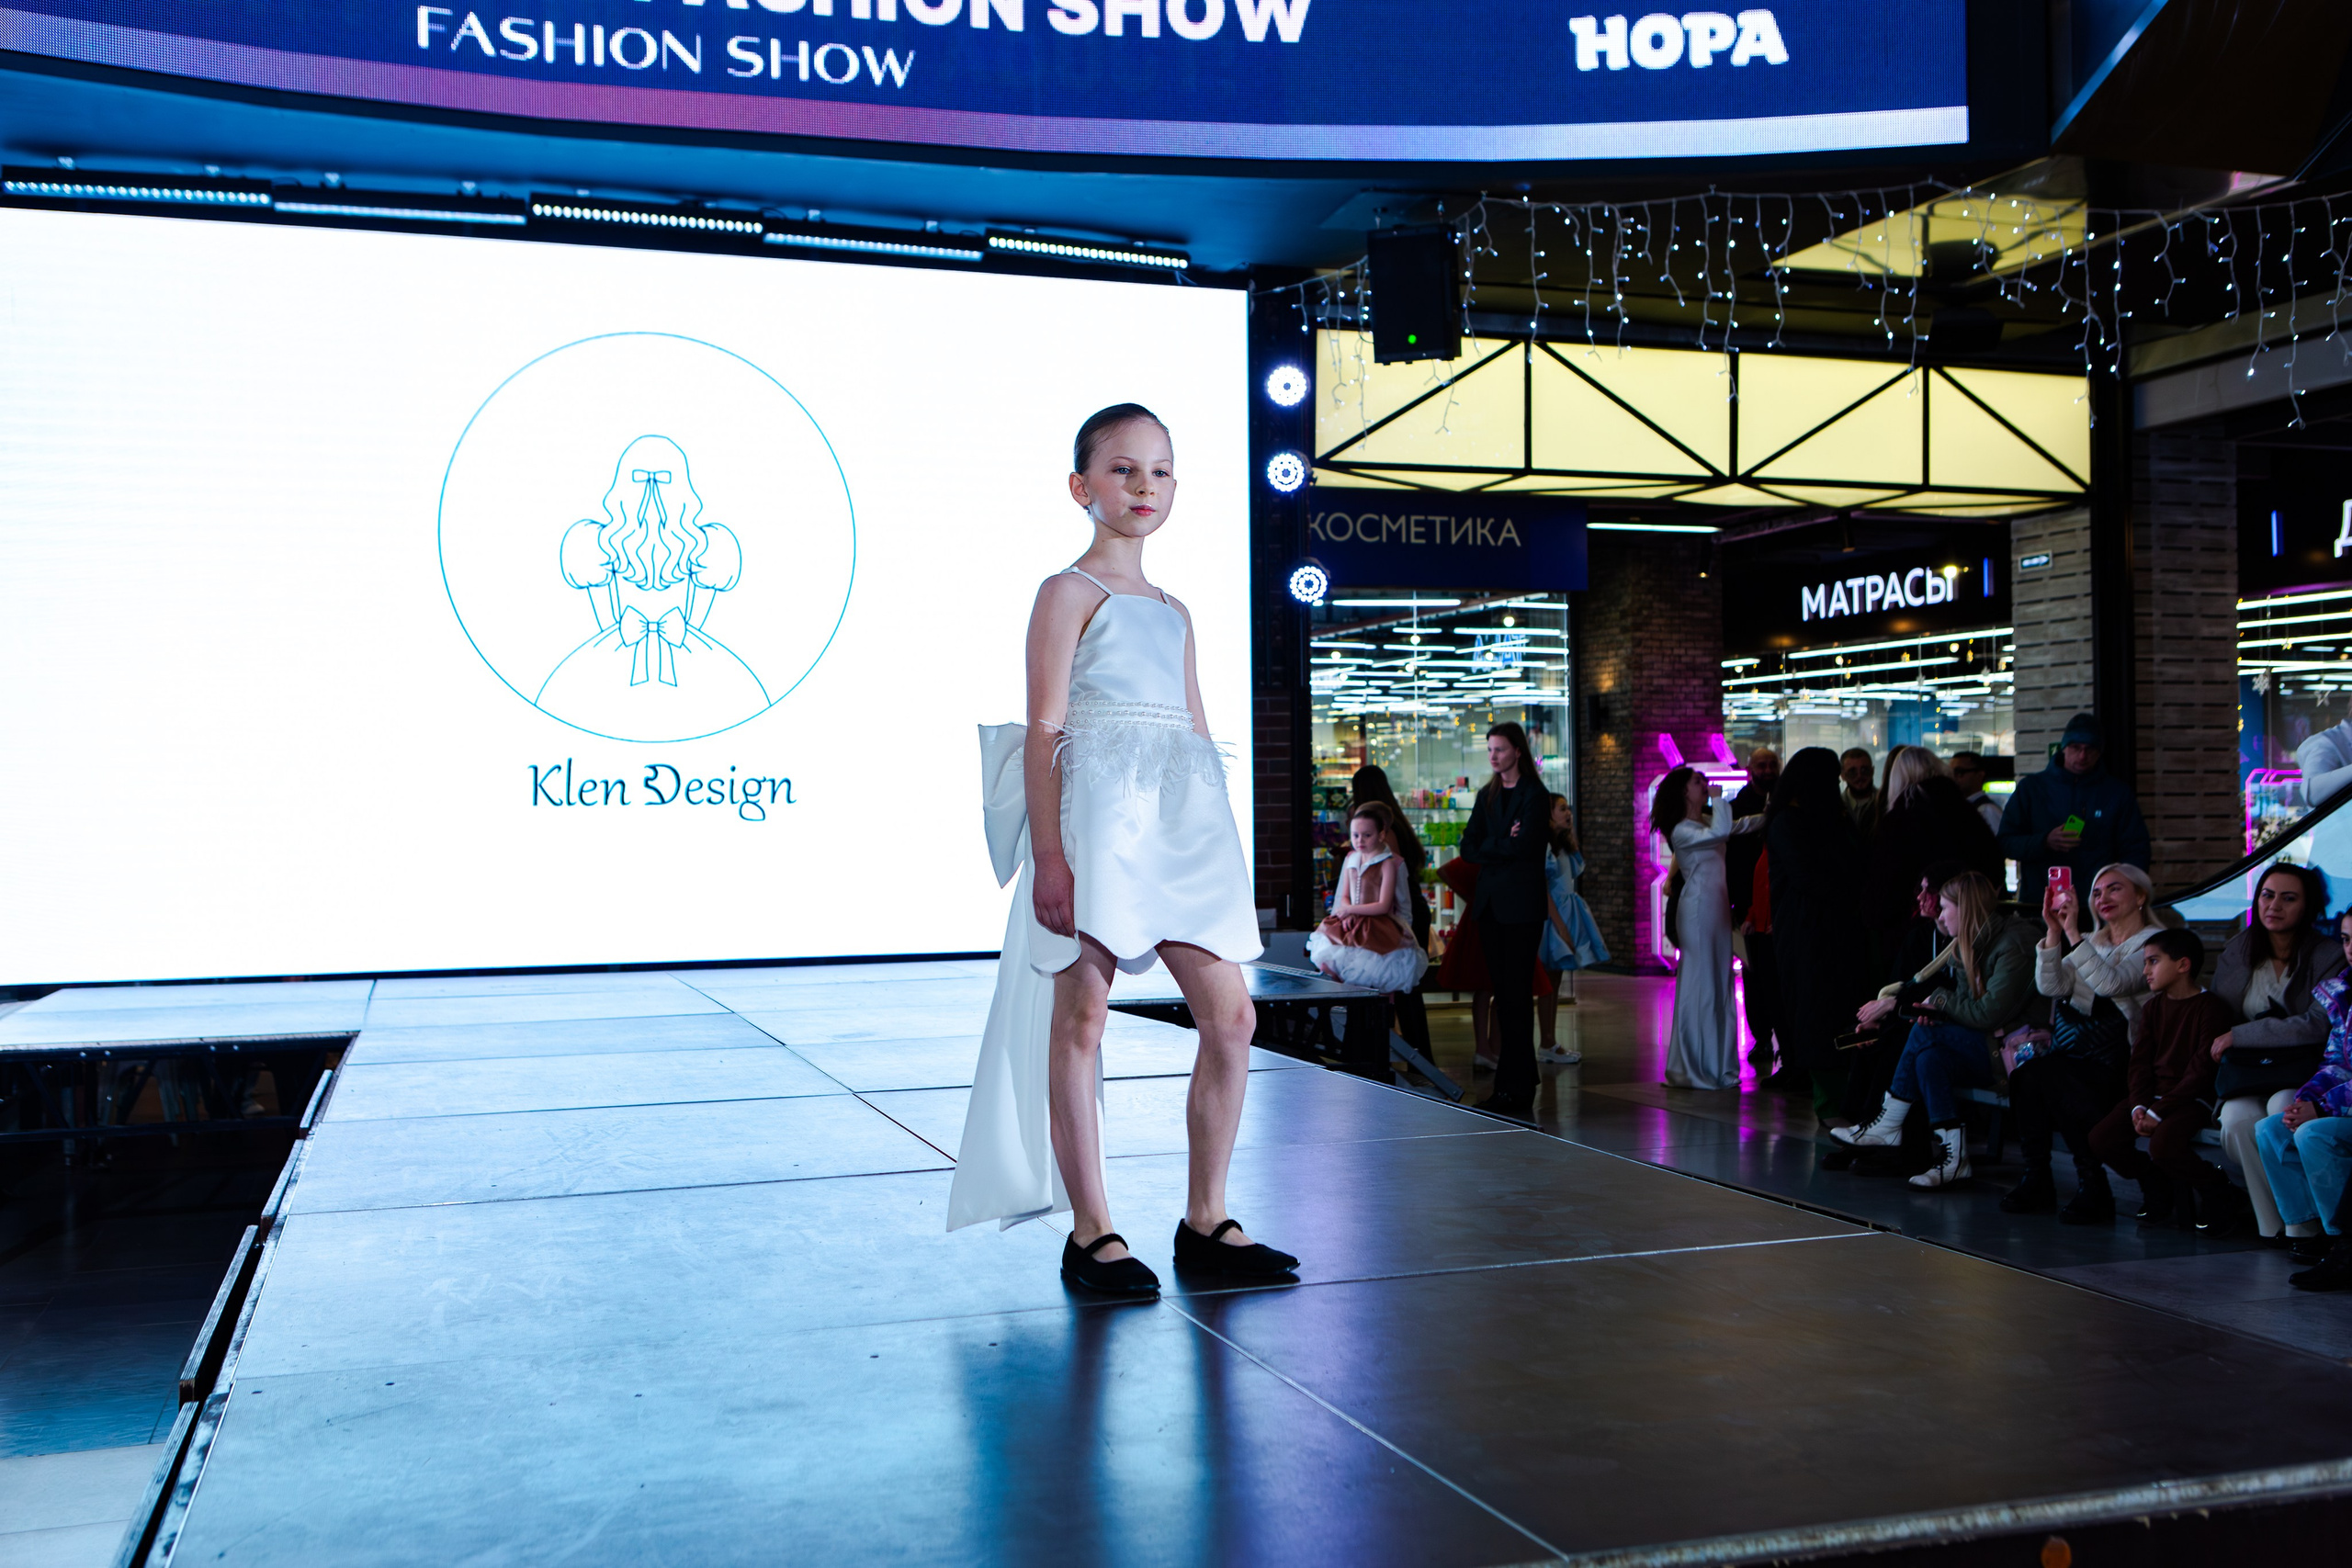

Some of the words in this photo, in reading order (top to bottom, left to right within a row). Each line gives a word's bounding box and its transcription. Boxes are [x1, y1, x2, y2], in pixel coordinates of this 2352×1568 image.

[417, 6, 701, 73] FASHION
[727, 35, 914, 88] SHOW
[1047, 0, 1311, 43] SHOW
[1310, 512, 1521, 547] КОСМЕТИКА
[1802, 566, 1955, 622] МАТРАСЫ
[527, 757, 631, 807] Klen
[644, 763, 797, 821] Design
